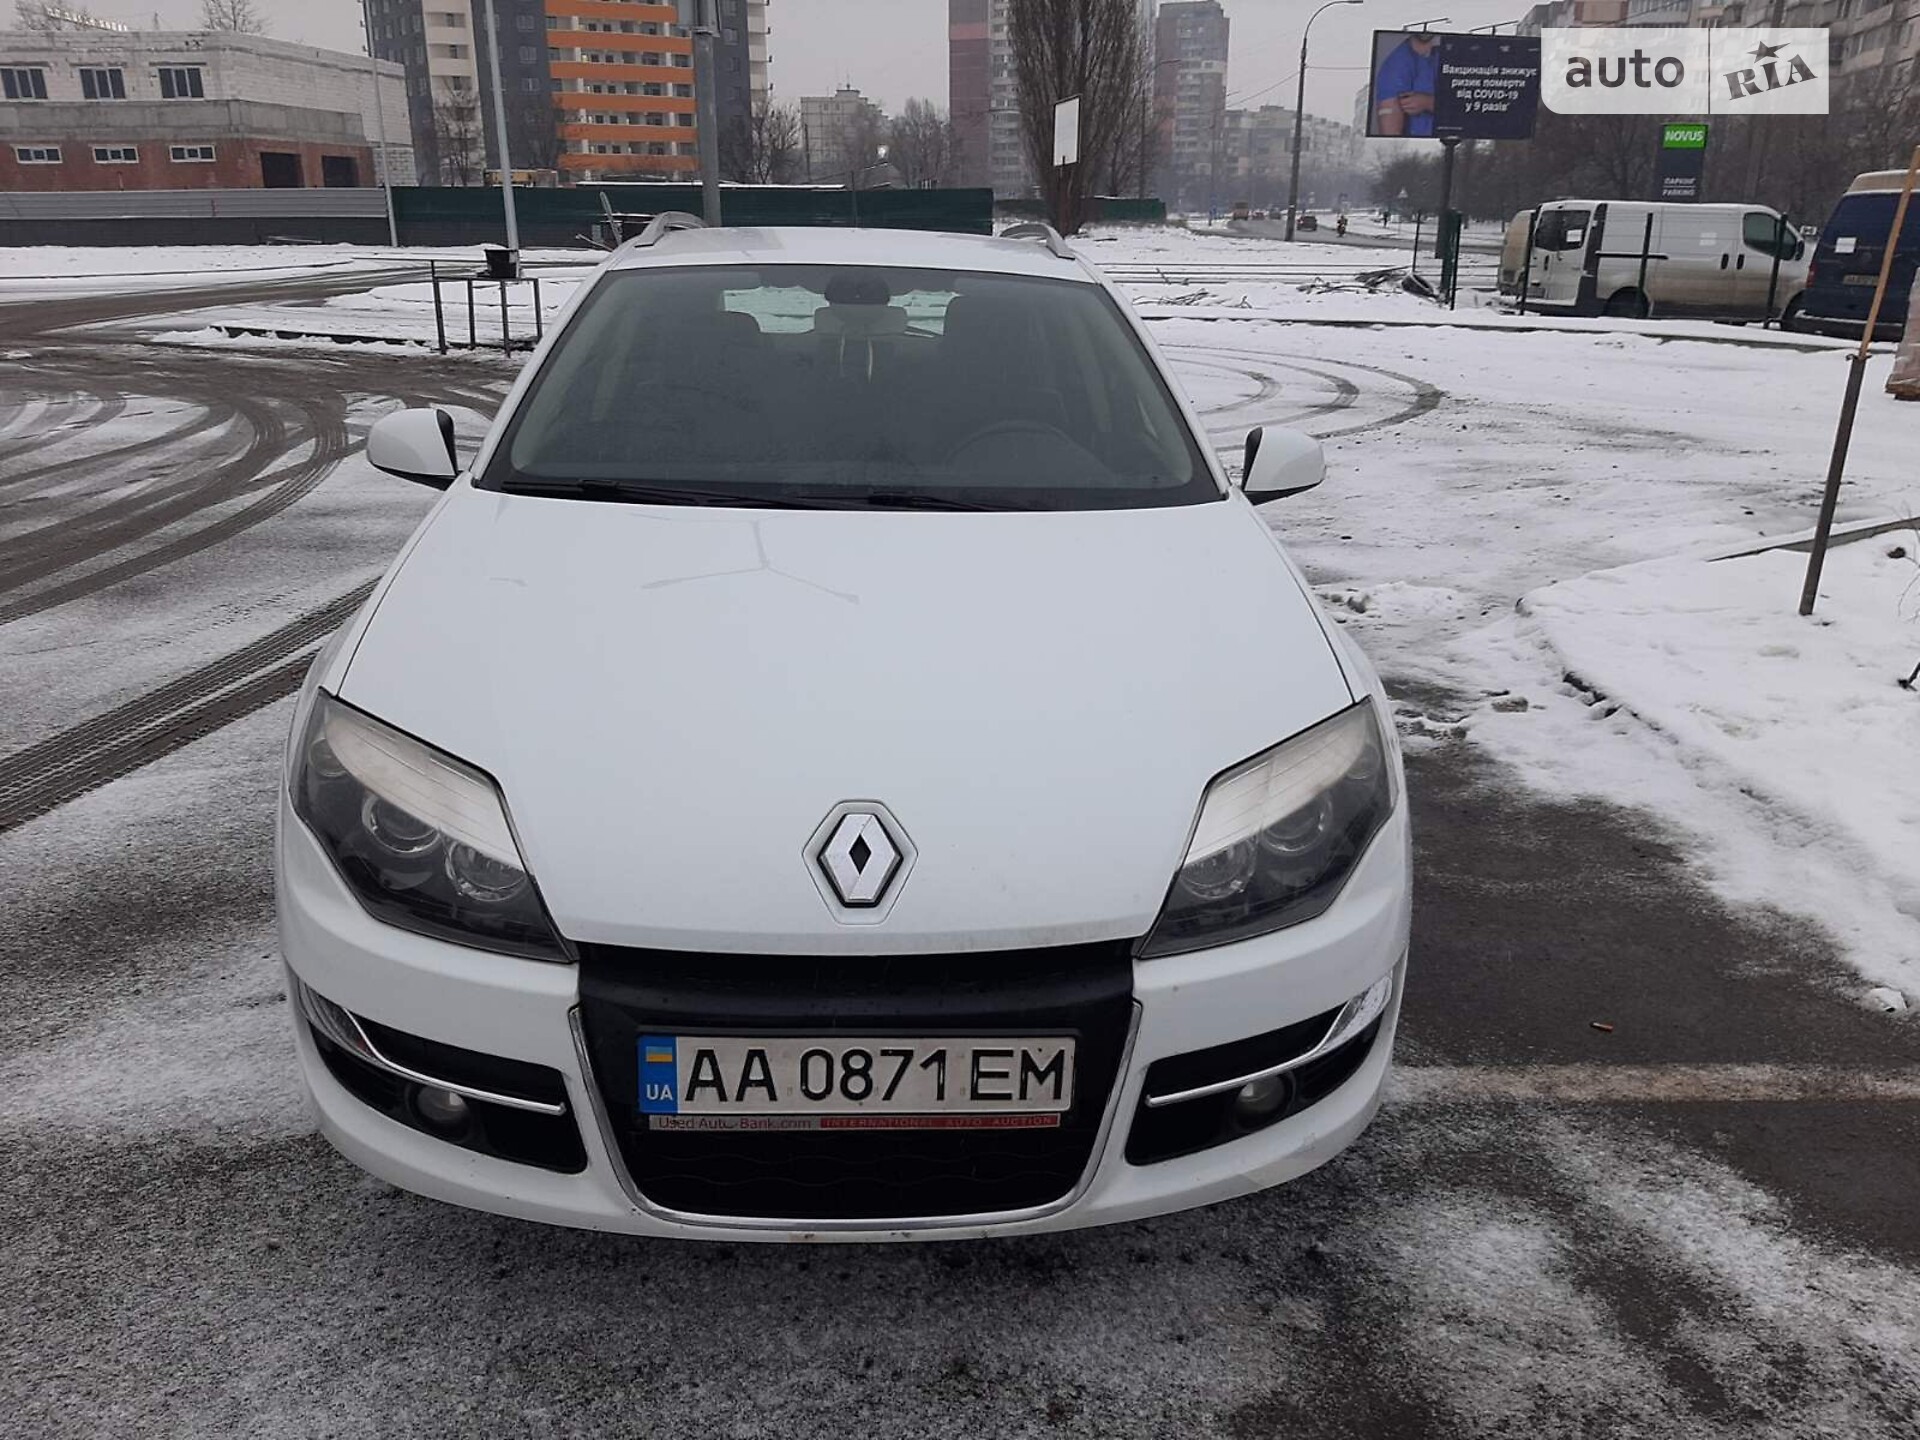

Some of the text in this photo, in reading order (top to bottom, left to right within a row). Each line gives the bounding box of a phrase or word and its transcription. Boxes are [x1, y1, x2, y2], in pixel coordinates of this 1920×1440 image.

[1451, 79, 1526, 88] ризик померти
[1457, 89, 1519, 99] від COVID-19
[1474, 101, 1480, 111] 9
[1665, 131, 1704, 142] NOVUS
[685, 1048, 1064, 1101] AA 0871 EM
[646, 1085, 673, 1100] UA
[826, 1115, 1052, 1128] INTERNATIONAL AUTO AUCTION
